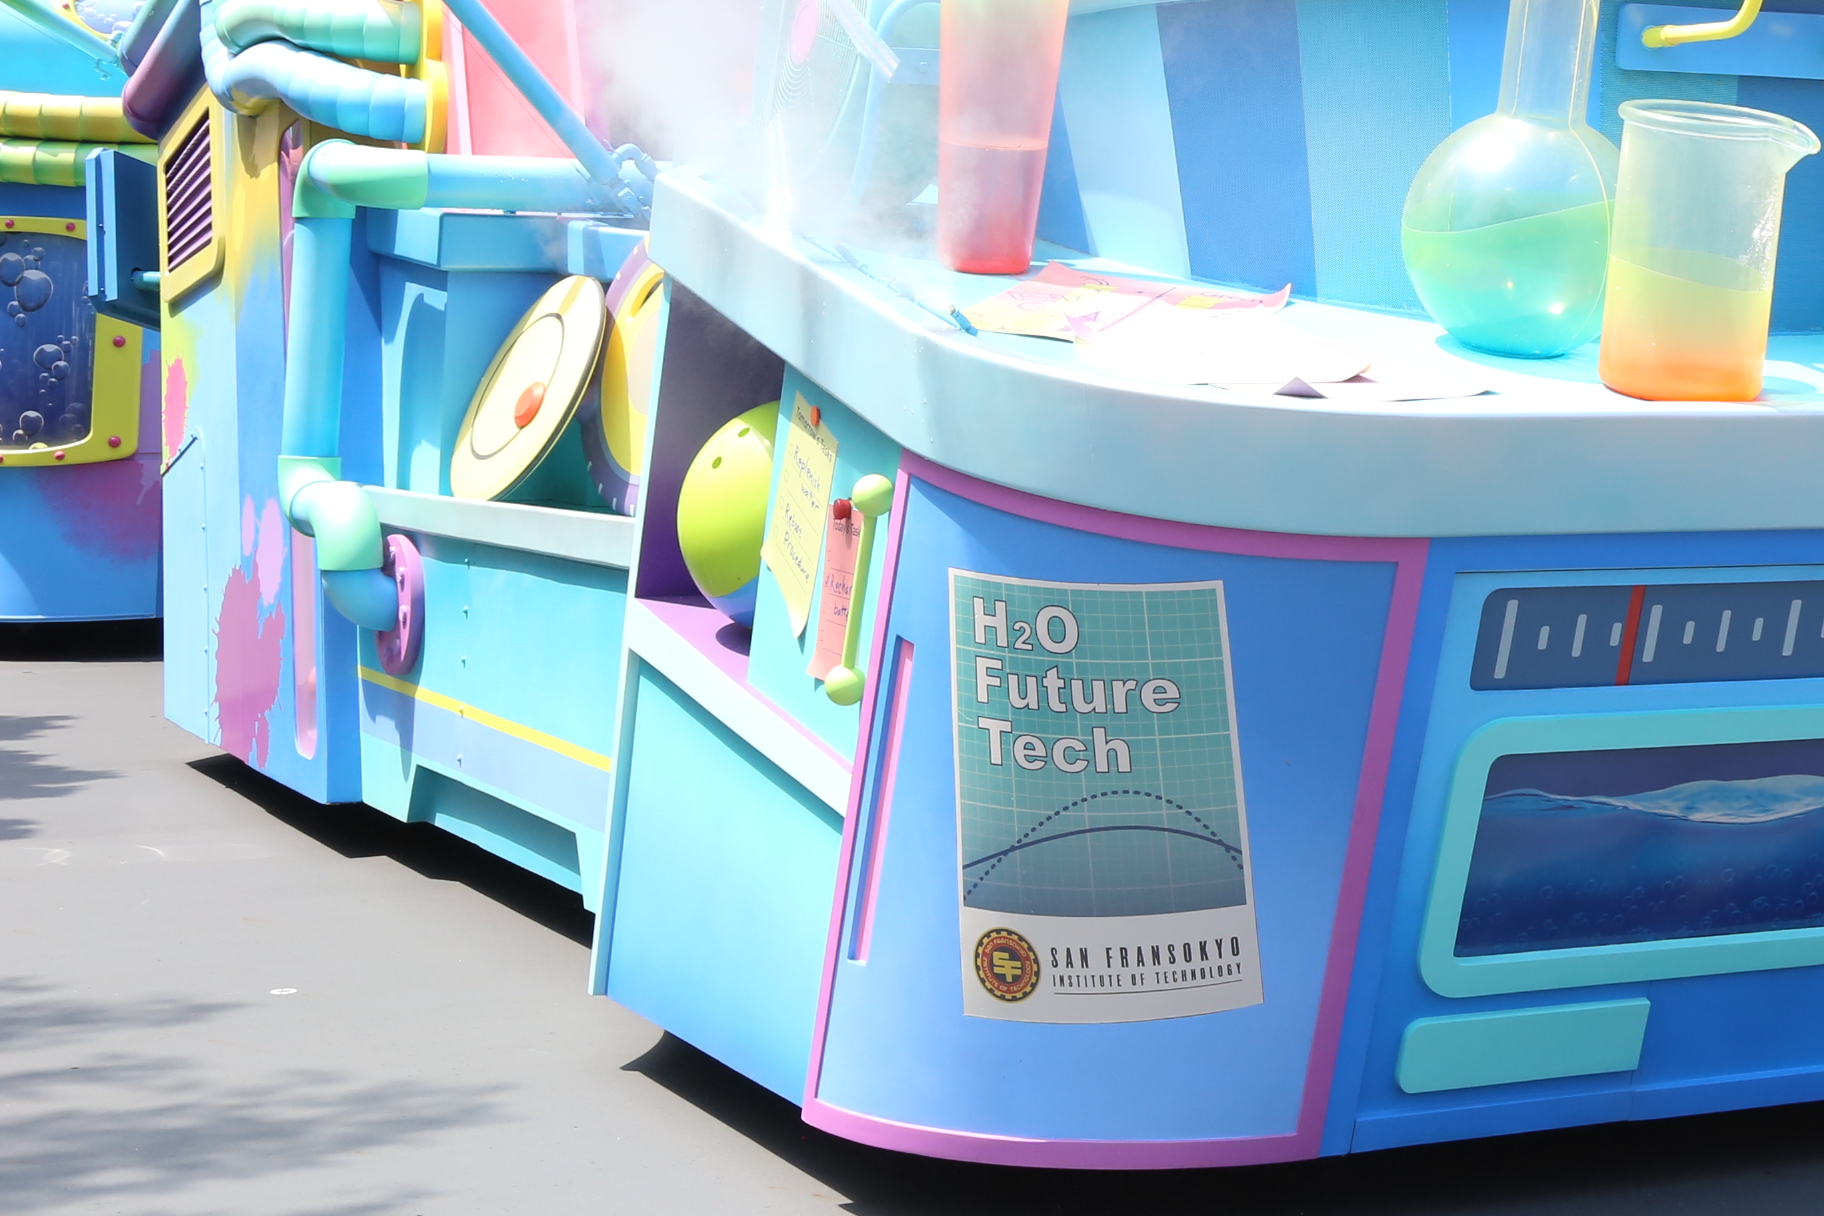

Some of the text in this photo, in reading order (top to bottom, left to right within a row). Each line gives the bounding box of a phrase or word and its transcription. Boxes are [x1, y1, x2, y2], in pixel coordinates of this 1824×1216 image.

[972, 595, 1080, 655] H2O
[974, 655, 1182, 715] Future
[977, 716, 1133, 774] Tech
[1050, 936, 1241, 969] SAN FRANSOKYO
[1052, 962, 1243, 987] INSTITUTE OF TECHNOLOGY
